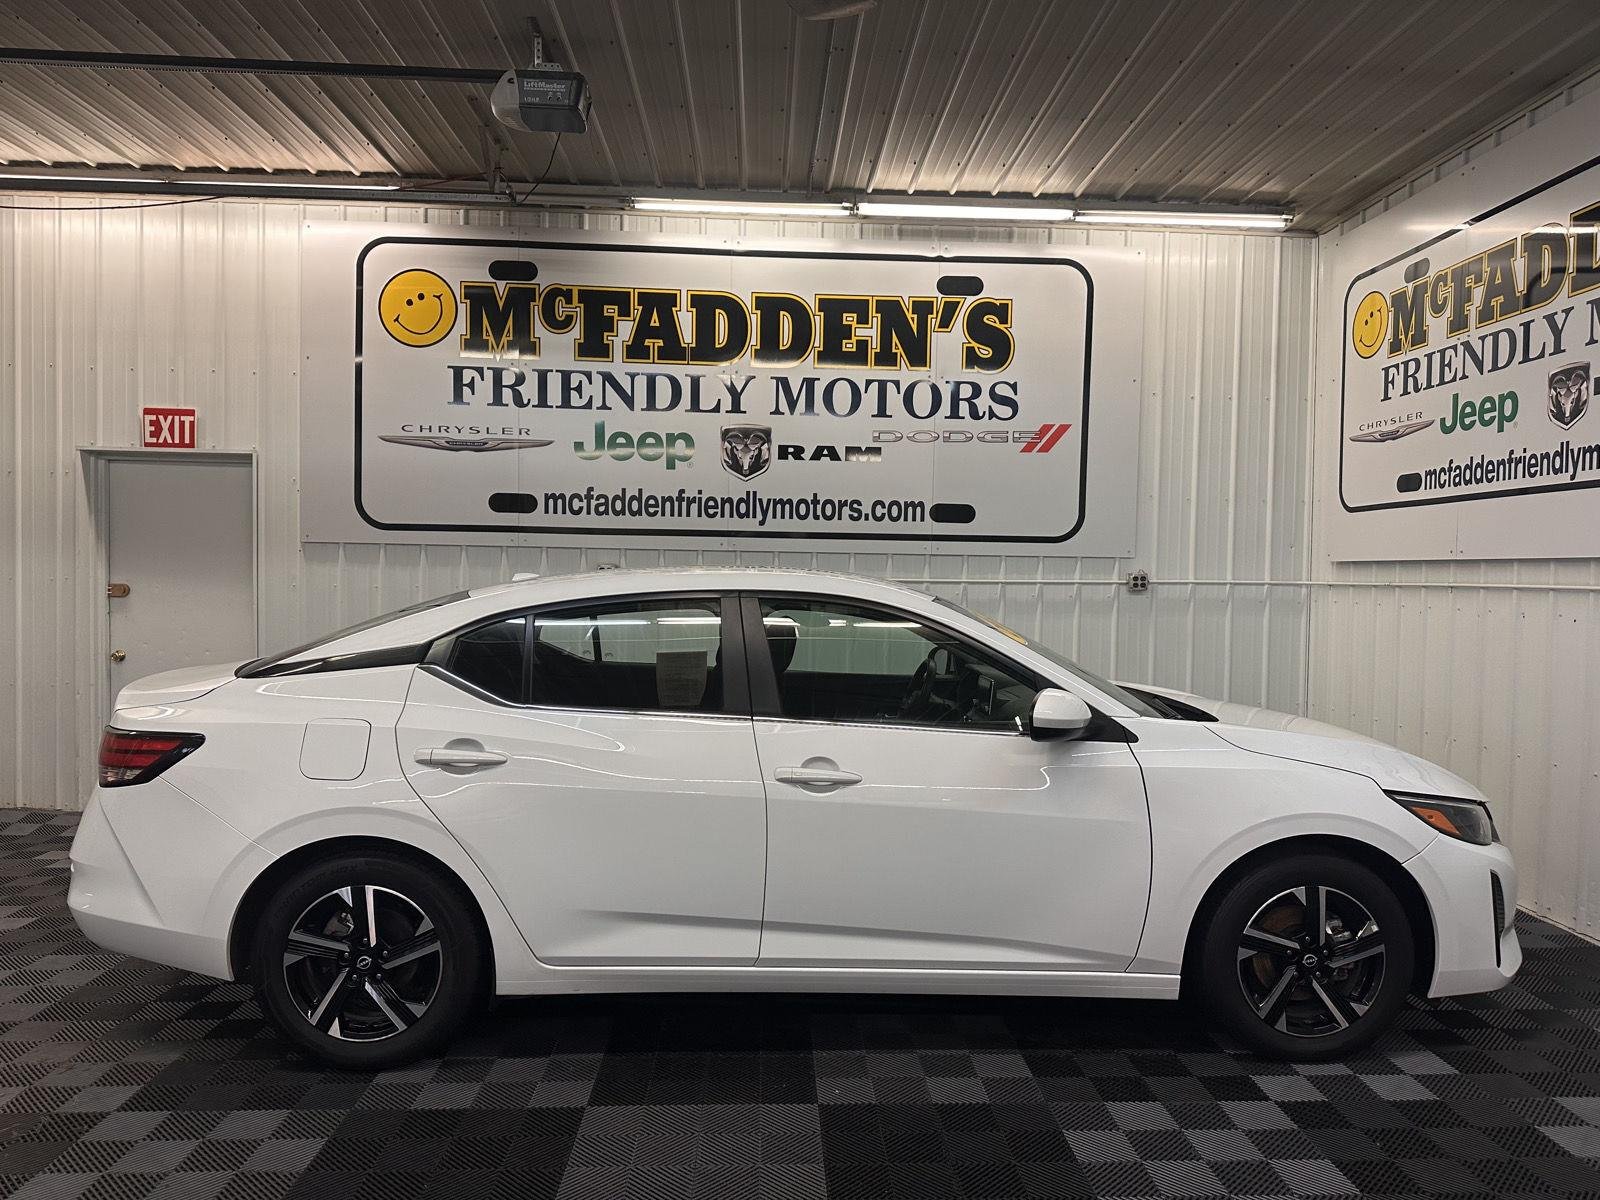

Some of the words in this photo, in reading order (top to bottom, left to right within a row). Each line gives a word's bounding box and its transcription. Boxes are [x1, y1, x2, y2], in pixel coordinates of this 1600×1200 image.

[1380, 305, 1575, 402] FRIENDLY
[447, 365, 757, 414] FRIENDLY
[769, 375, 1020, 421] MOTORS
[144, 414, 195, 444] EXIT
[401, 424, 531, 436] CHRYSLER
[1359, 411, 1423, 432] CHRYSLER
[1440, 390, 1519, 435] Jeep
[573, 420, 696, 470] Jeep
[777, 445, 882, 462] RAM
[872, 430, 1042, 443] DODGE
[543, 486, 926, 526] mcfaddenfriendlymotors.com
